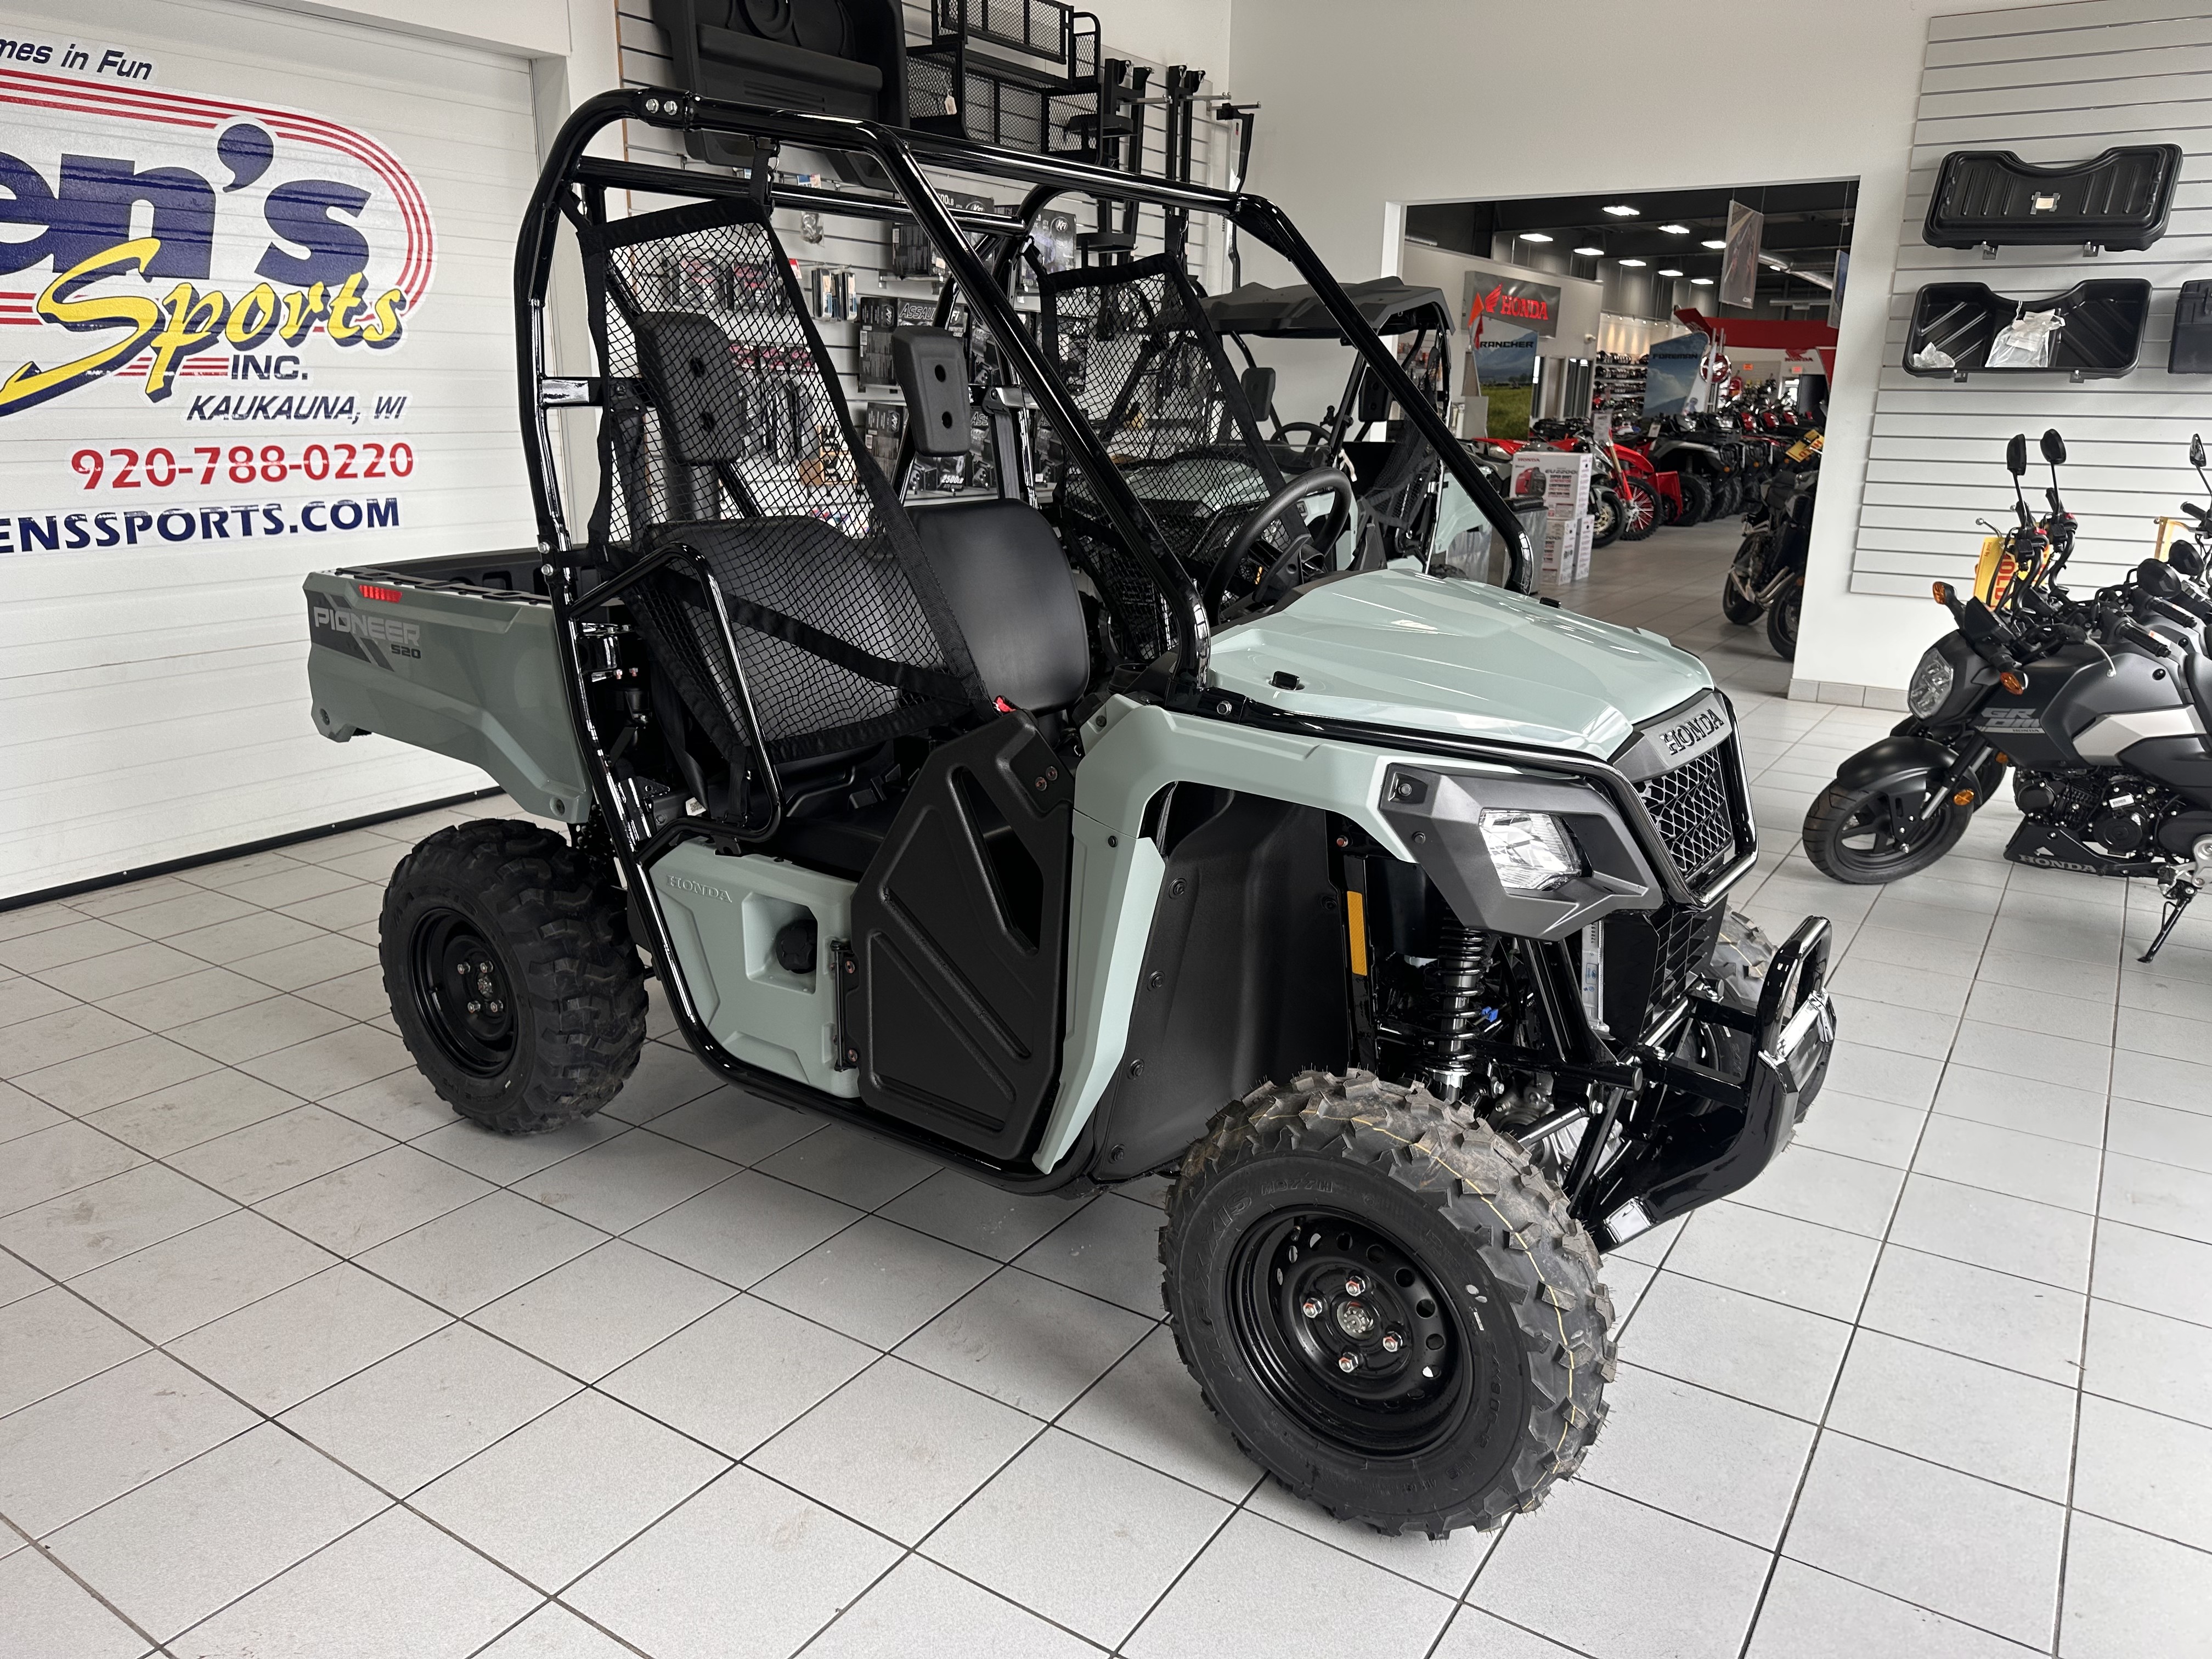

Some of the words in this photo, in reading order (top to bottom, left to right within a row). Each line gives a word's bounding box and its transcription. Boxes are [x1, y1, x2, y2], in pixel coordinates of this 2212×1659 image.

[0, 38, 50, 64] mes
[61, 44, 89, 71] in
[97, 50, 153, 80] Fun
[0, 123, 372, 287] en's
[899, 303, 936, 320] ASSAU
[950, 310, 960, 323] Fi
[1500, 295, 1549, 320] HONDA
[0, 238, 407, 417] Sports
[231, 355, 308, 381] INC.
[187, 396, 361, 425] KAUKAUNA,
[375, 396, 407, 420] WI
[71, 442, 414, 490] 920-788-0220
[0, 498, 400, 554] ENSSPORTS.COM
[313, 606, 421, 646] PIONEER
[391, 644, 421, 659] 520
[1659, 708, 1724, 755] HONDA
[2019, 854, 2096, 873] HONDA
[666, 875, 732, 903] HONDA
[1261, 1180, 1334, 1197] M977H
